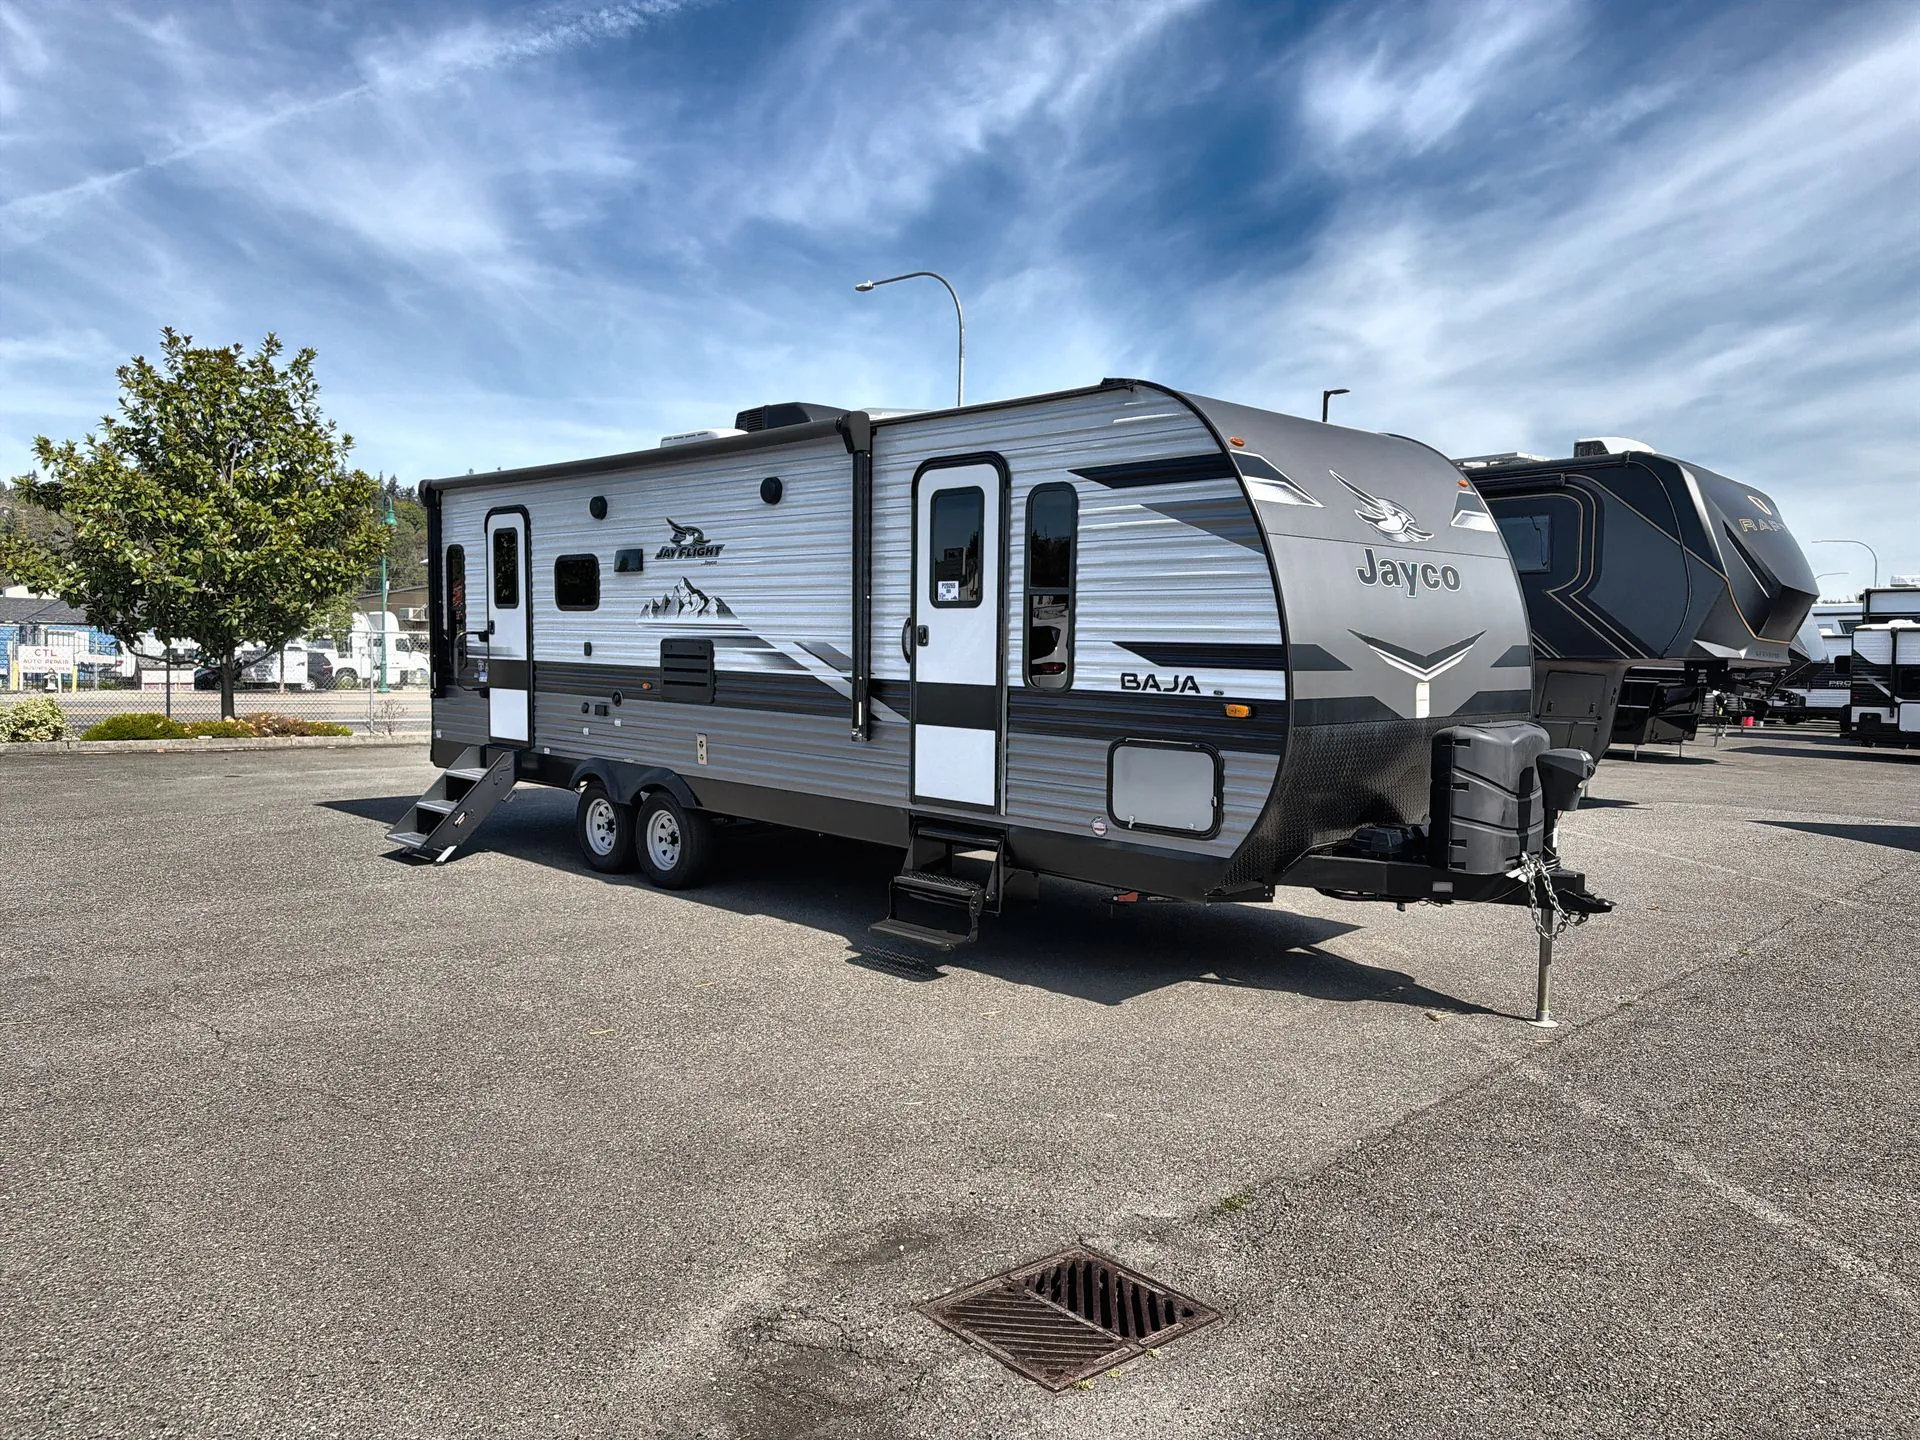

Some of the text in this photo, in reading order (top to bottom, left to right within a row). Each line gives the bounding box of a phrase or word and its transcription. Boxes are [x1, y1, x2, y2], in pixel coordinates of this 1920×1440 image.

[655, 544, 725, 560] JAY FLIGHT
[1356, 547, 1462, 598] Jayco
[34, 648, 57, 657] CTL
[1120, 672, 1202, 694] BAJA
